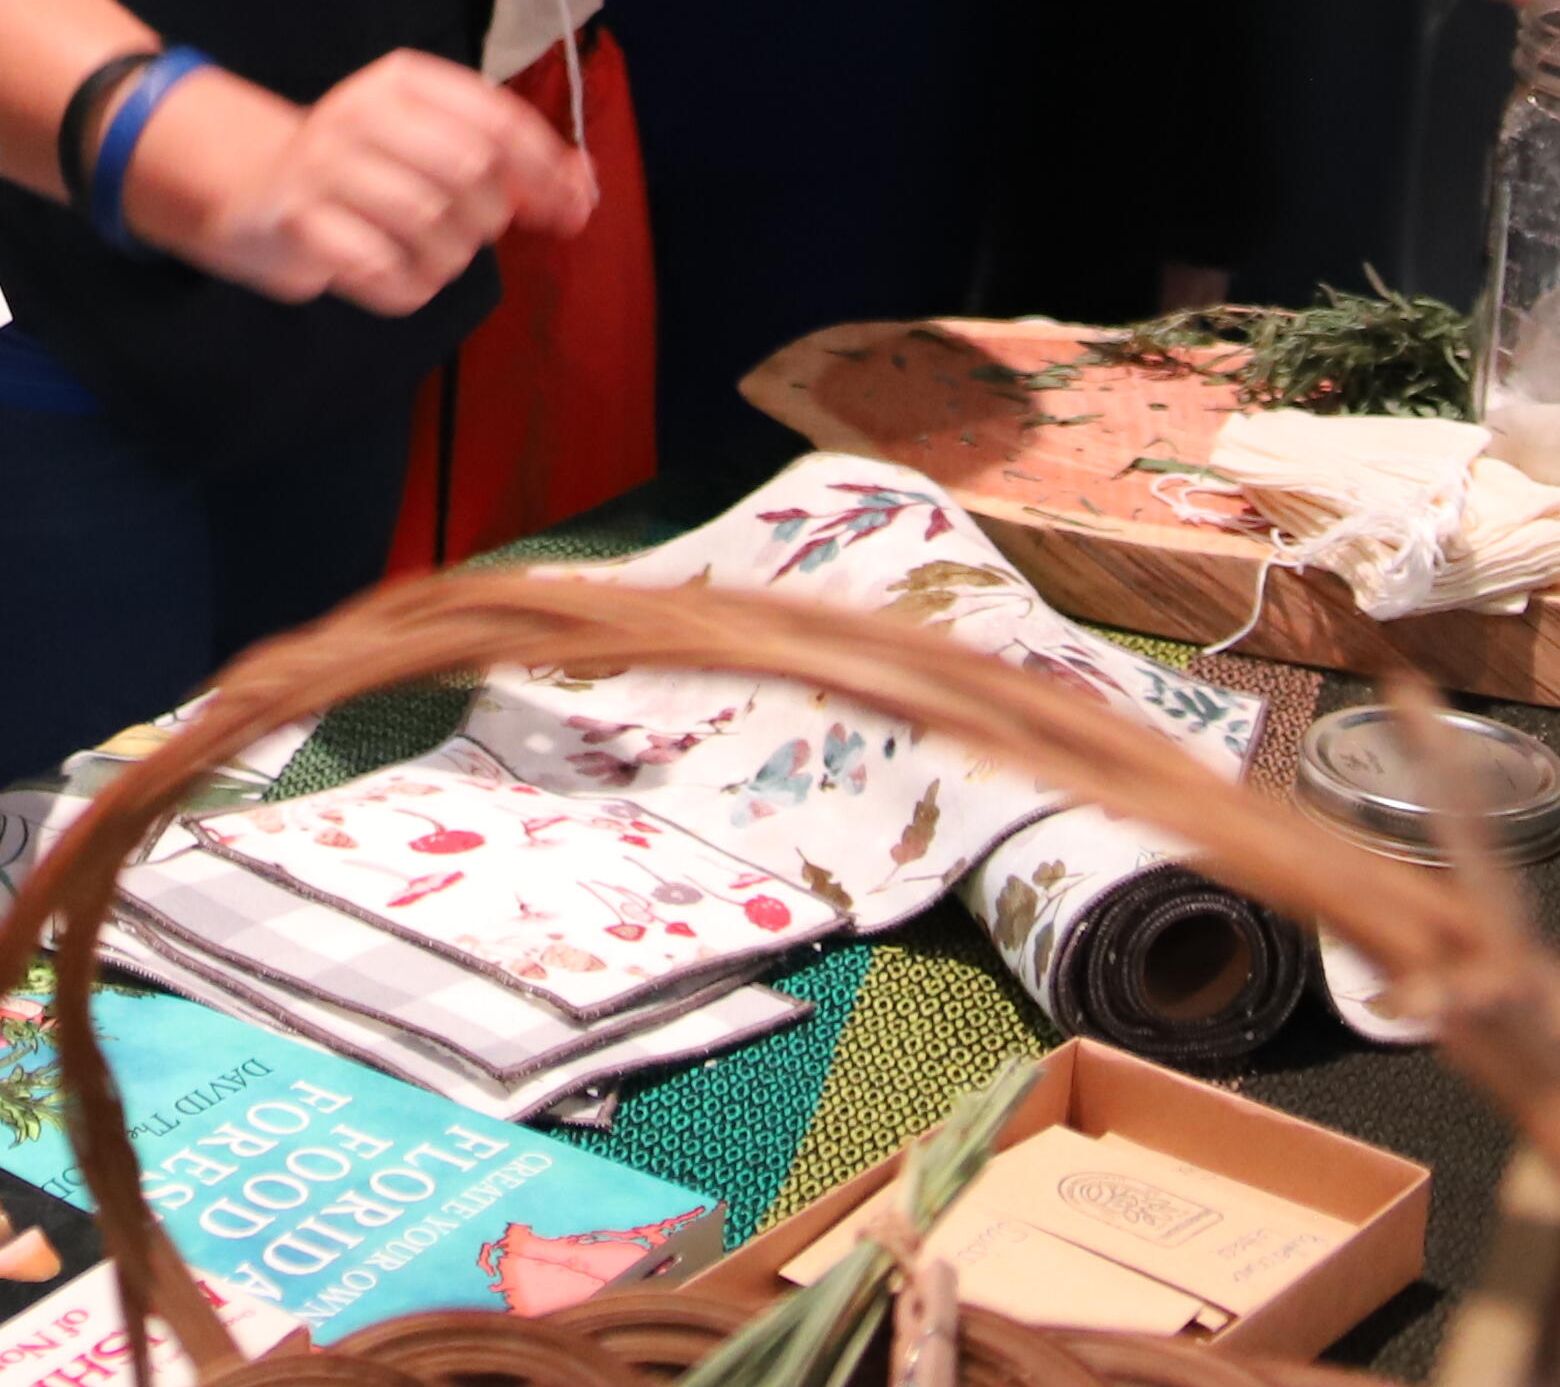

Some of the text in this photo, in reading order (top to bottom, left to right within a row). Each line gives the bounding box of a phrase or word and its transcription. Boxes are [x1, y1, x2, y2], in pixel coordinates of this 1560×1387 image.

[125, 1101, 183, 1142] The
[173, 1056, 274, 1126] DAVID
[140, 1079, 354, 1225] FORES
[199, 1123, 396, 1241] FOOD
[218, 1123, 510, 1304] FLORIDA
[308, 1151, 554, 1328] CREATE YOUR OWN
[58, 1307, 90, 1340] of
